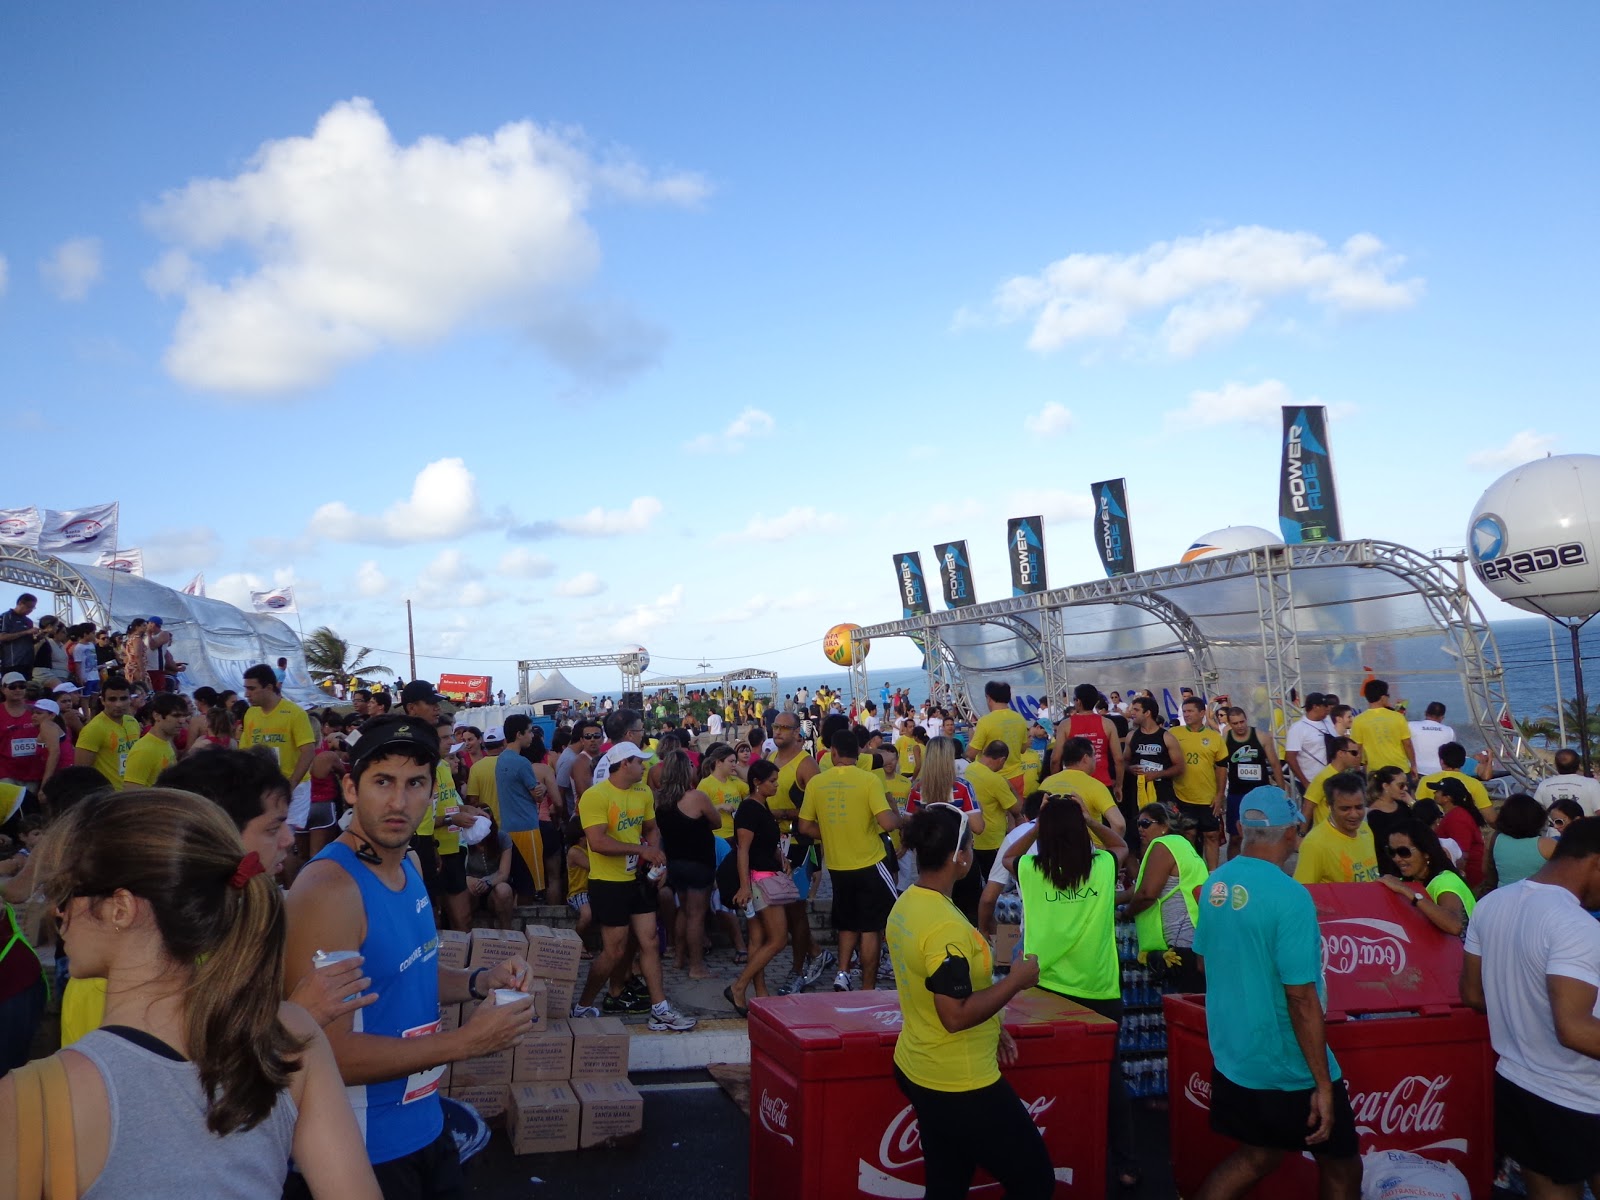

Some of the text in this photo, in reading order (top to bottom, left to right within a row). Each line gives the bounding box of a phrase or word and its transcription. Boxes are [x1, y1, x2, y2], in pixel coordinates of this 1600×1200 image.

[1287, 425, 1310, 513] POWER
[1302, 462, 1324, 511] ADE
[1100, 496, 1115, 562] POWER
[1110, 523, 1124, 561] ADE
[945, 552, 959, 600] POWER
[1017, 529, 1032, 585] POWER
[1029, 552, 1039, 584] ADE
[901, 562, 916, 605] POWER
[912, 579, 923, 604] ADE
[956, 570, 967, 598] ADE
[14, 743, 36, 751] 0653
[1186, 752, 1199, 765] 23
[1240, 768, 1258, 776] 0048
[1045, 887, 1098, 902] UNIKA
[1343, 1074, 1453, 1135] ca-Cola
